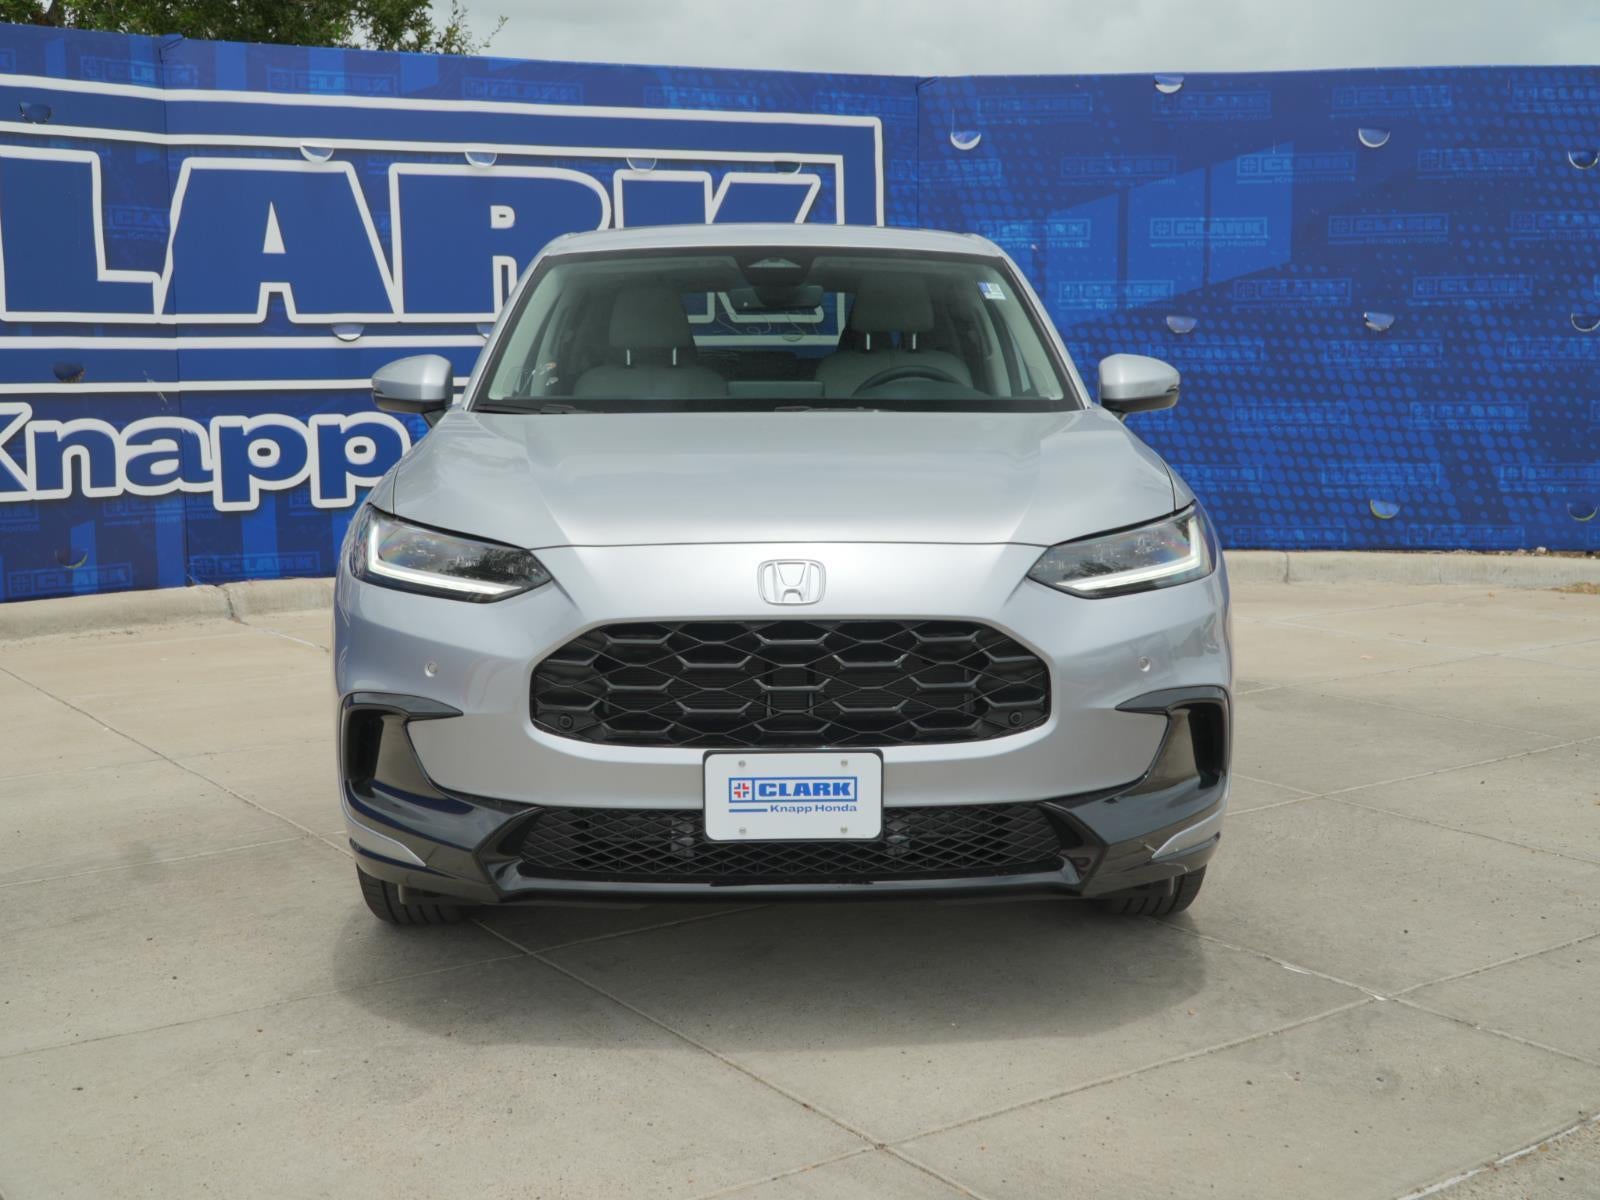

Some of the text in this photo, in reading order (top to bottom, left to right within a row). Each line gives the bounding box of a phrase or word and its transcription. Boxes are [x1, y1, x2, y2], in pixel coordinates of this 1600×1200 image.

[758, 782, 851, 797] CLARK
[770, 803, 857, 814] Knapp Honda
